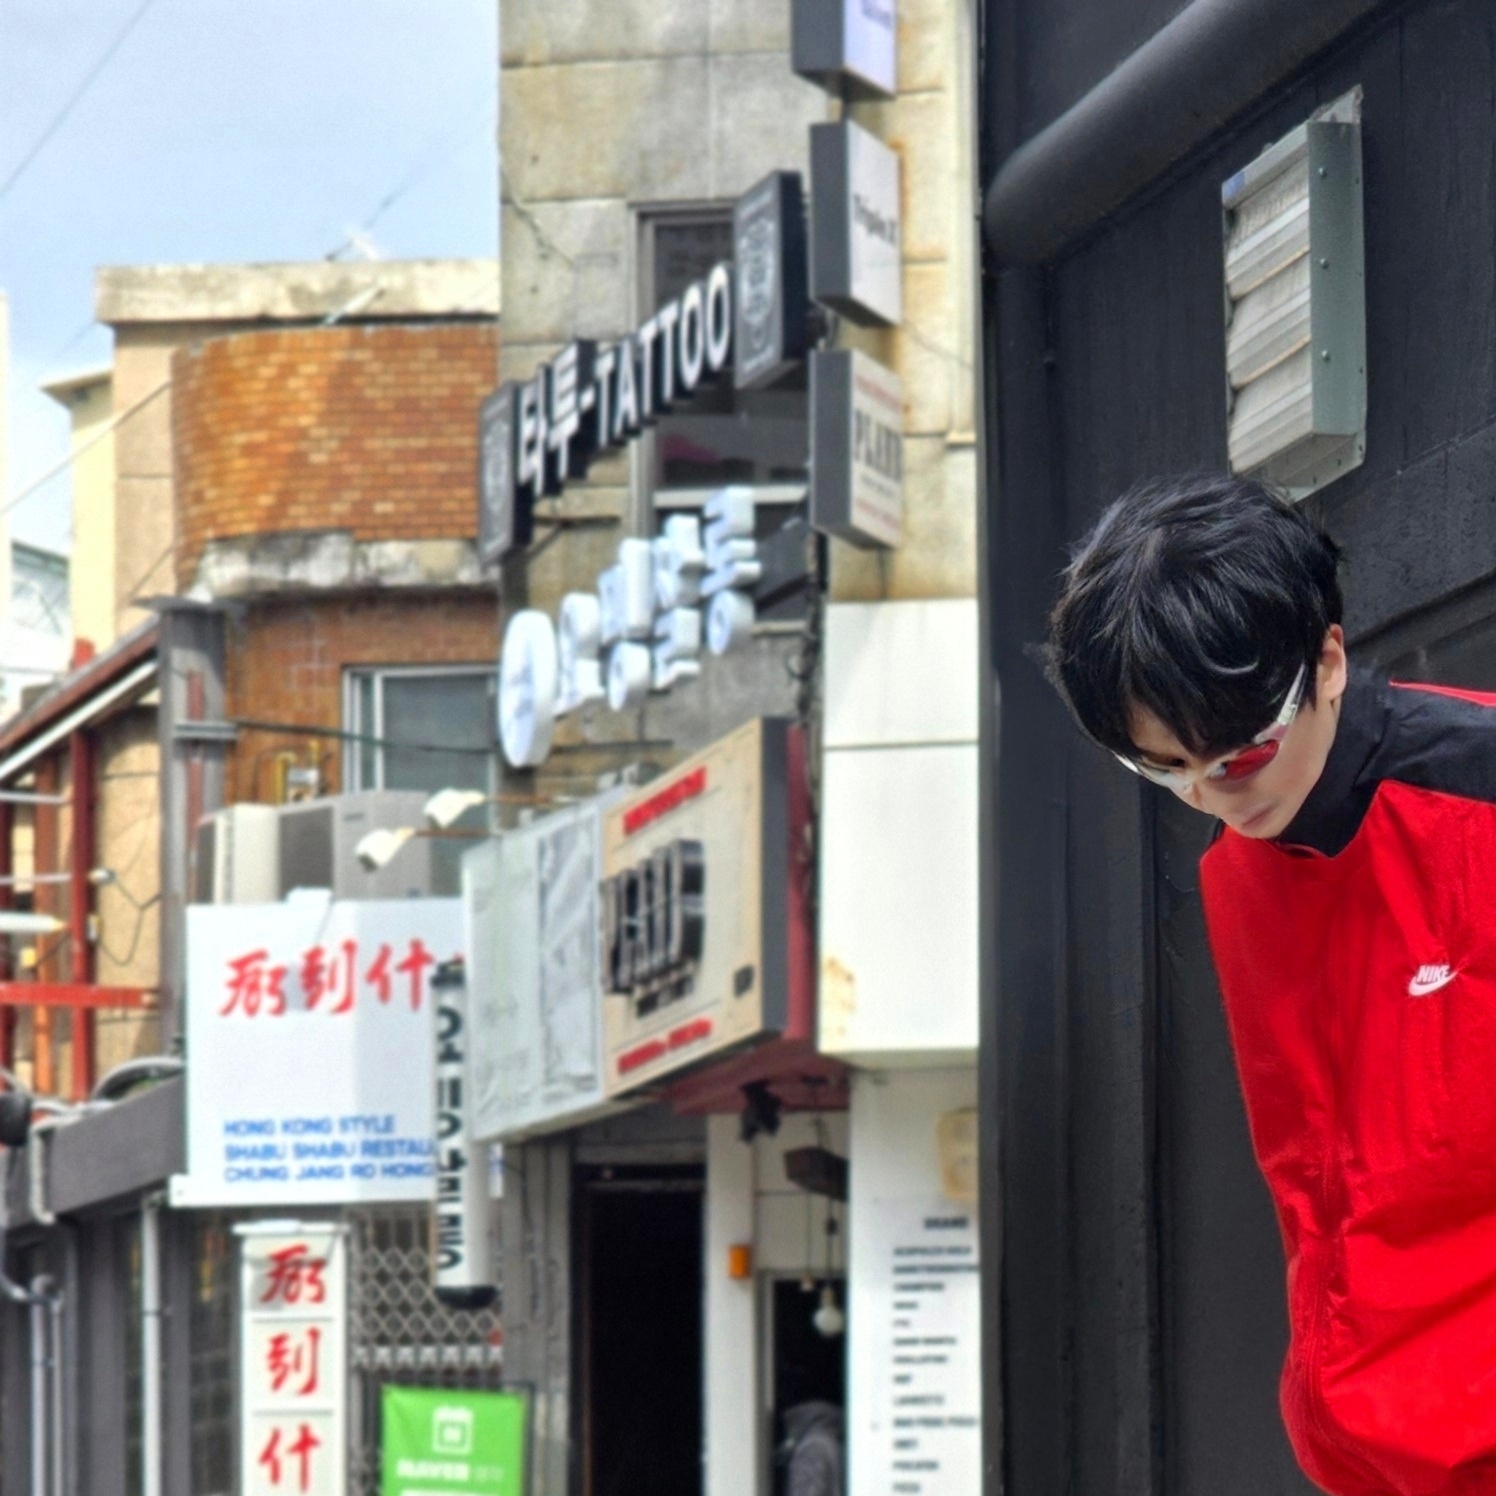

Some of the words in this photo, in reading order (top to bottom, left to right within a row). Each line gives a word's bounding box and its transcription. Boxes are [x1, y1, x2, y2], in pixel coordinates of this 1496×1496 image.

[1416, 965, 1450, 983] NIKE
[224, 1120, 275, 1135] HONG
[282, 1118, 331, 1133] KONG
[339, 1115, 394, 1133] STYLE
[225, 1144, 285, 1160] SHABU
[294, 1142, 355, 1158] SHABU
[225, 1167, 289, 1181] CHUNG
[295, 1165, 344, 1180] JANG
[351, 1163, 374, 1178] RO
